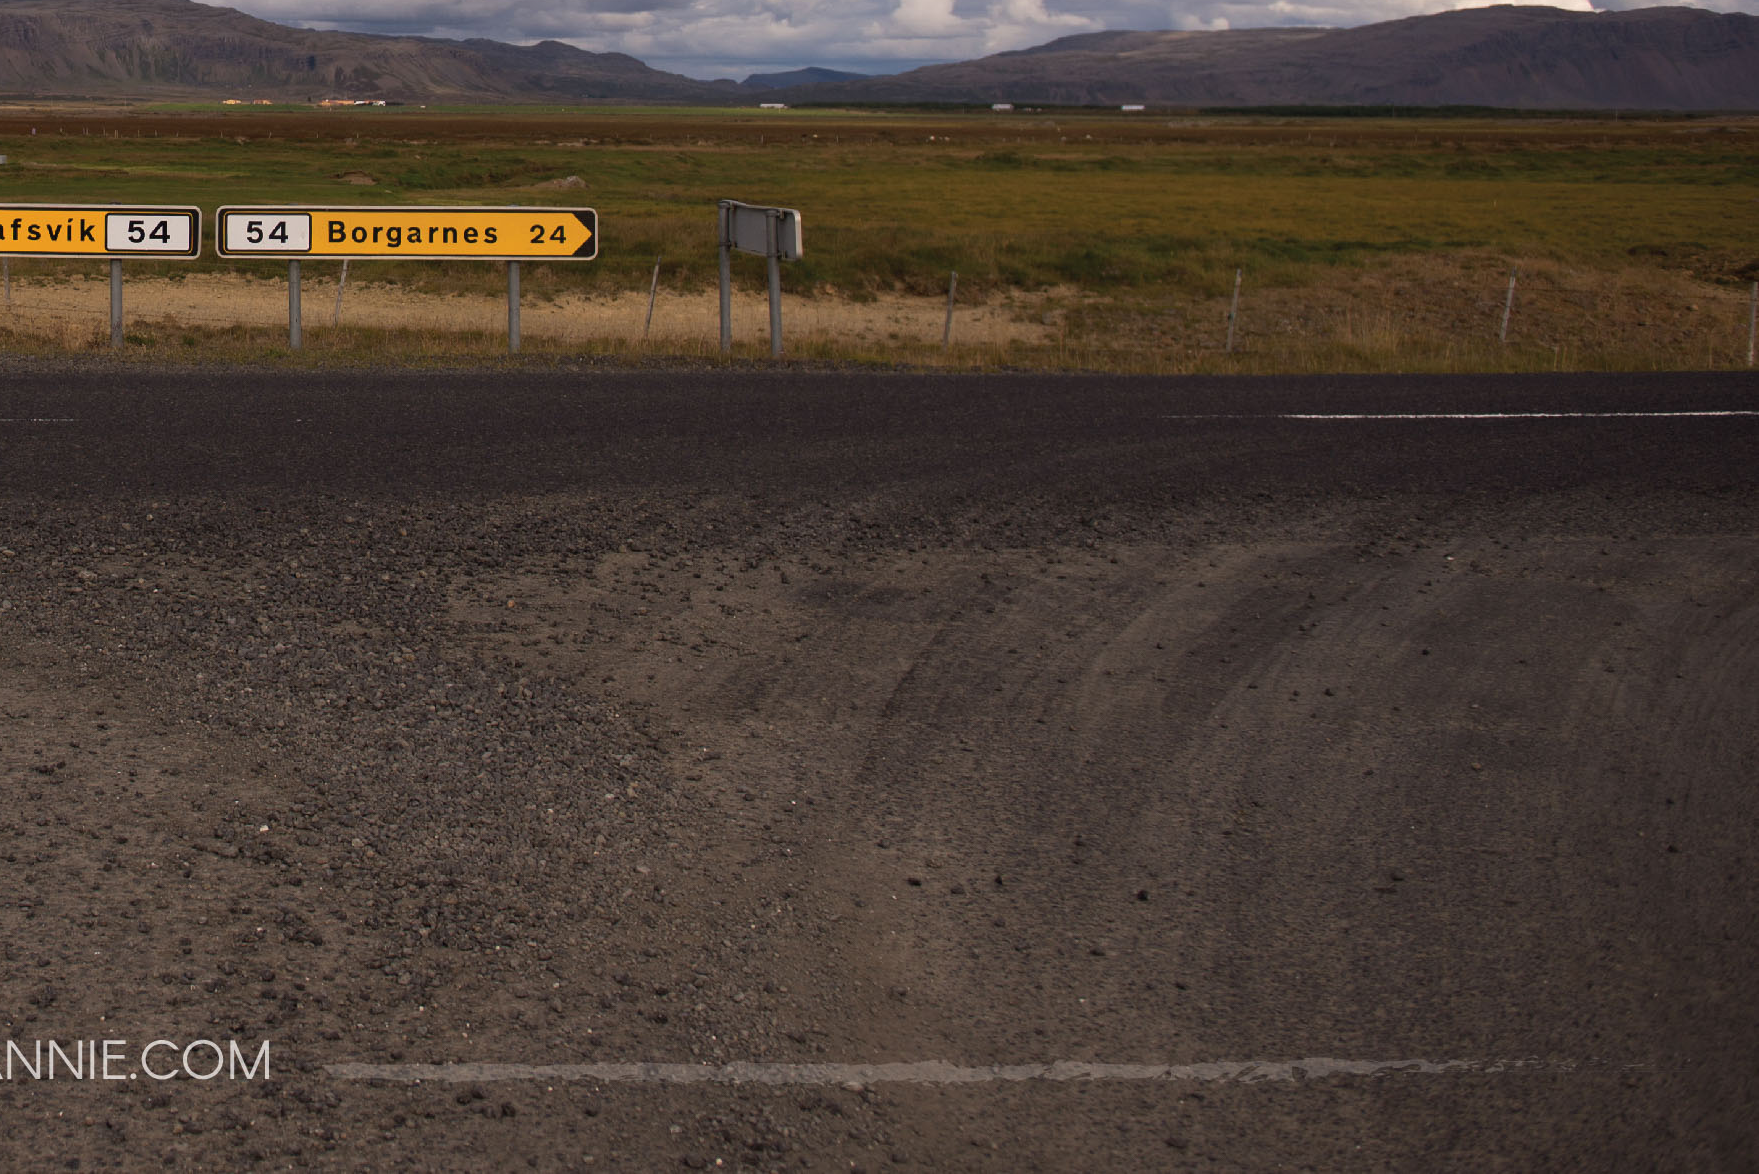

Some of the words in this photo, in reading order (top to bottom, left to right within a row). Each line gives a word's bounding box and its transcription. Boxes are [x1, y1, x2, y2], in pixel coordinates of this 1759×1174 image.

[127, 220, 171, 244] 54
[246, 221, 289, 244] 54
[328, 220, 498, 248] Borgarnes
[529, 224, 567, 244] 24
